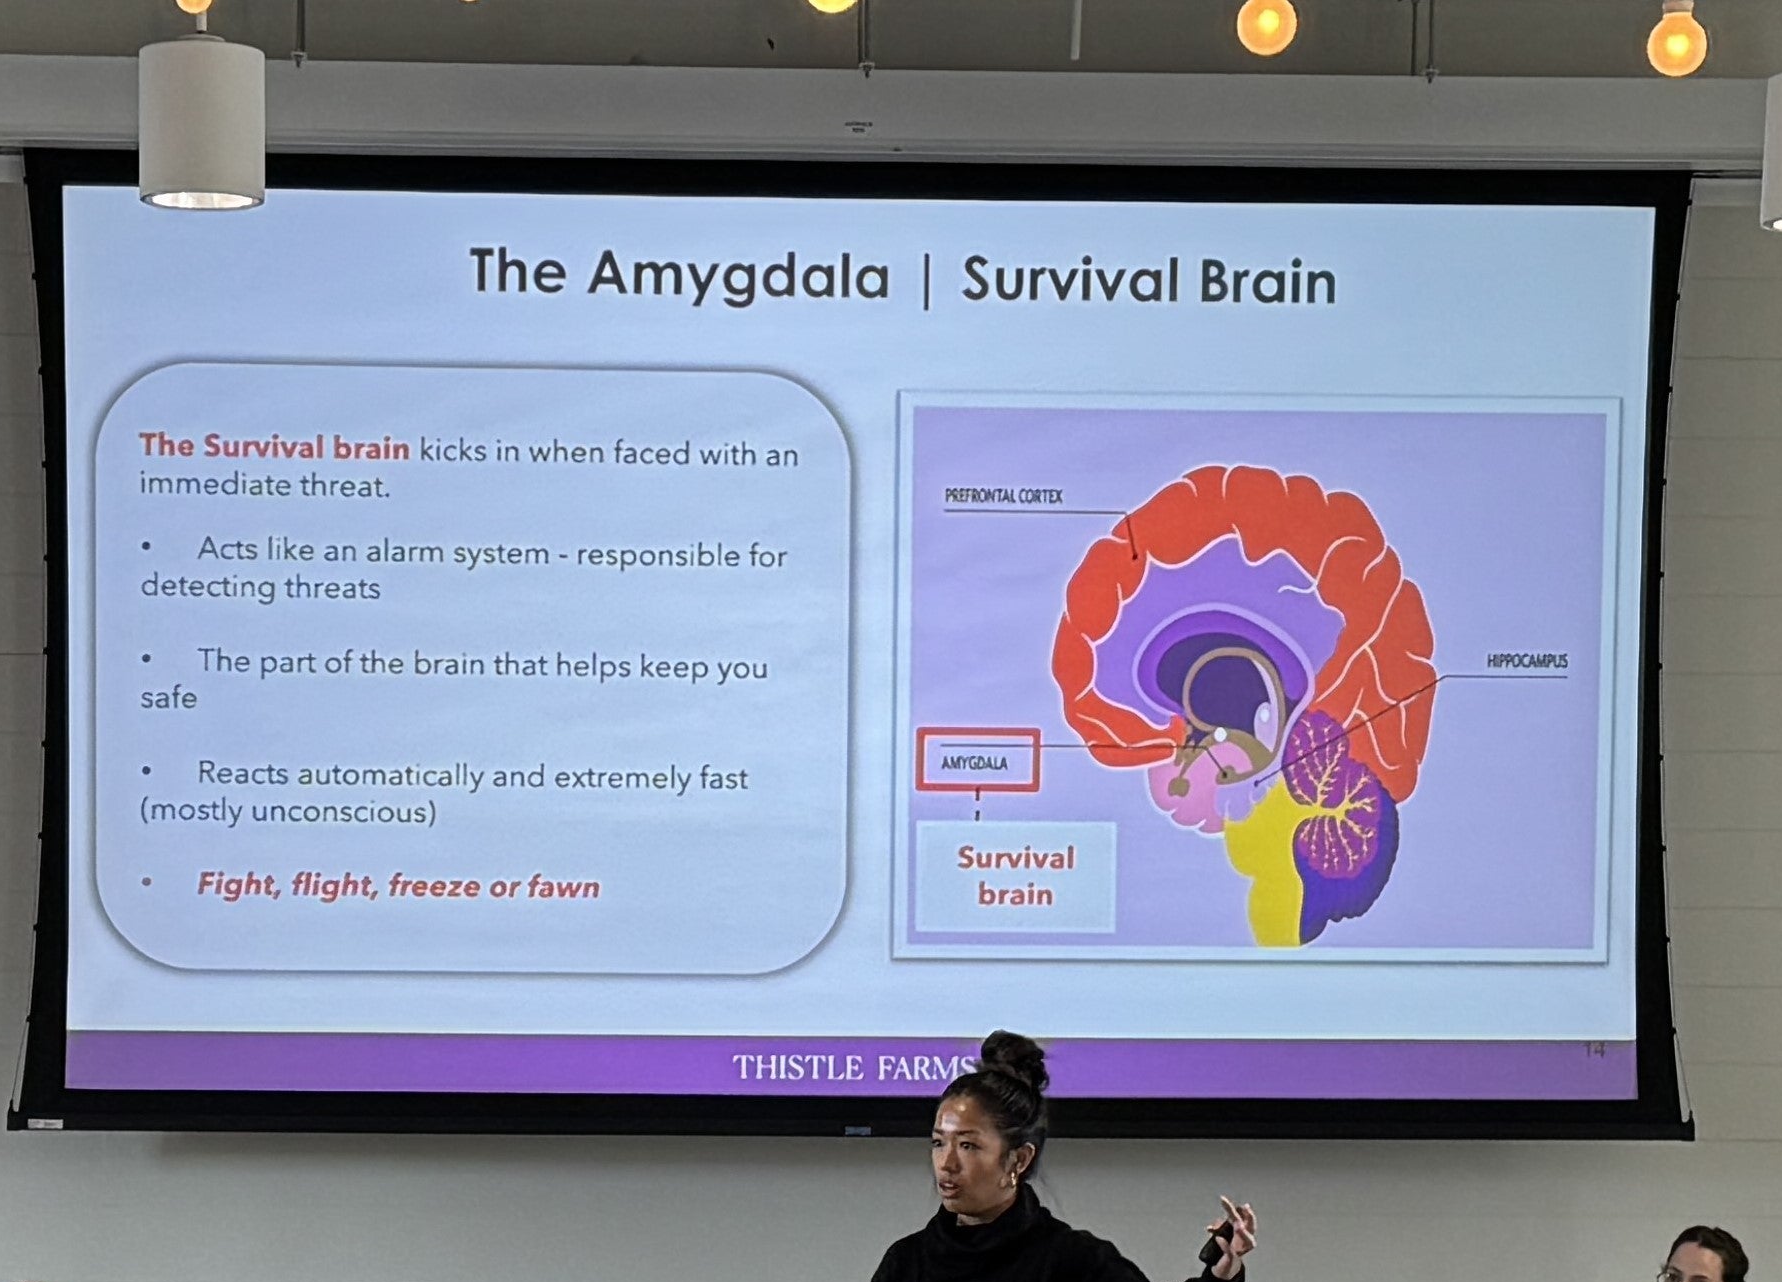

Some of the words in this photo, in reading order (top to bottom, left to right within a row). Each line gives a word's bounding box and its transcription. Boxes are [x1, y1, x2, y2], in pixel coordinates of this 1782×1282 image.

[470, 247, 566, 293] The
[588, 250, 888, 308] Amygdala
[962, 255, 1178, 302] Survival
[1202, 258, 1335, 304] Brain
[139, 432, 194, 456] The
[204, 434, 323, 458] Survival
[334, 435, 409, 459] brain
[421, 436, 486, 461] kicks
[497, 439, 519, 461] in
[529, 439, 604, 463] when
[614, 439, 689, 465] faced
[700, 441, 756, 465] with
[767, 449, 798, 466] an
[141, 470, 291, 496] immediate
[300, 472, 389, 497] threat.
[946, 488, 1016, 503] PREFRONTAL
[1019, 488, 1062, 504] CORTEX
[198, 536, 257, 560] Acts
[268, 536, 314, 561] like
[324, 545, 356, 561] an
[367, 537, 443, 562] alarm
[454, 545, 549, 571] system
[578, 542, 740, 572] responsible
[749, 542, 787, 567] for
[142, 571, 275, 605] detecting
[284, 574, 380, 599] threats
[197, 647, 250, 672] The
[261, 653, 316, 680] part
[325, 649, 353, 673] of
[360, 649, 403, 674] the
[415, 650, 484, 675] brain
[494, 652, 548, 676] that
[557, 652, 630, 683] helps
[641, 653, 708, 684] keep
[717, 662, 767, 685] you
[1488, 653, 1568, 668] HIPPOCAMPUS
[142, 684, 197, 708] safe
[942, 756, 1008, 770] AMYGDALA
[199, 760, 288, 785] Reacts
[298, 763, 484, 793] automatically
[493, 763, 544, 787] and
[555, 765, 691, 796] extremely
[700, 764, 748, 789] fast
[141, 796, 242, 828] (mostly
[253, 800, 435, 827] unconscious)
[958, 845, 1073, 869] Survival
[198, 871, 281, 902] Fight,
[292, 872, 378, 902] flight,
[389, 873, 480, 897] freeze
[490, 881, 521, 897] or
[528, 874, 599, 898] fawn
[979, 881, 1052, 905] brain
[733, 1055, 864, 1080] THISTLE
